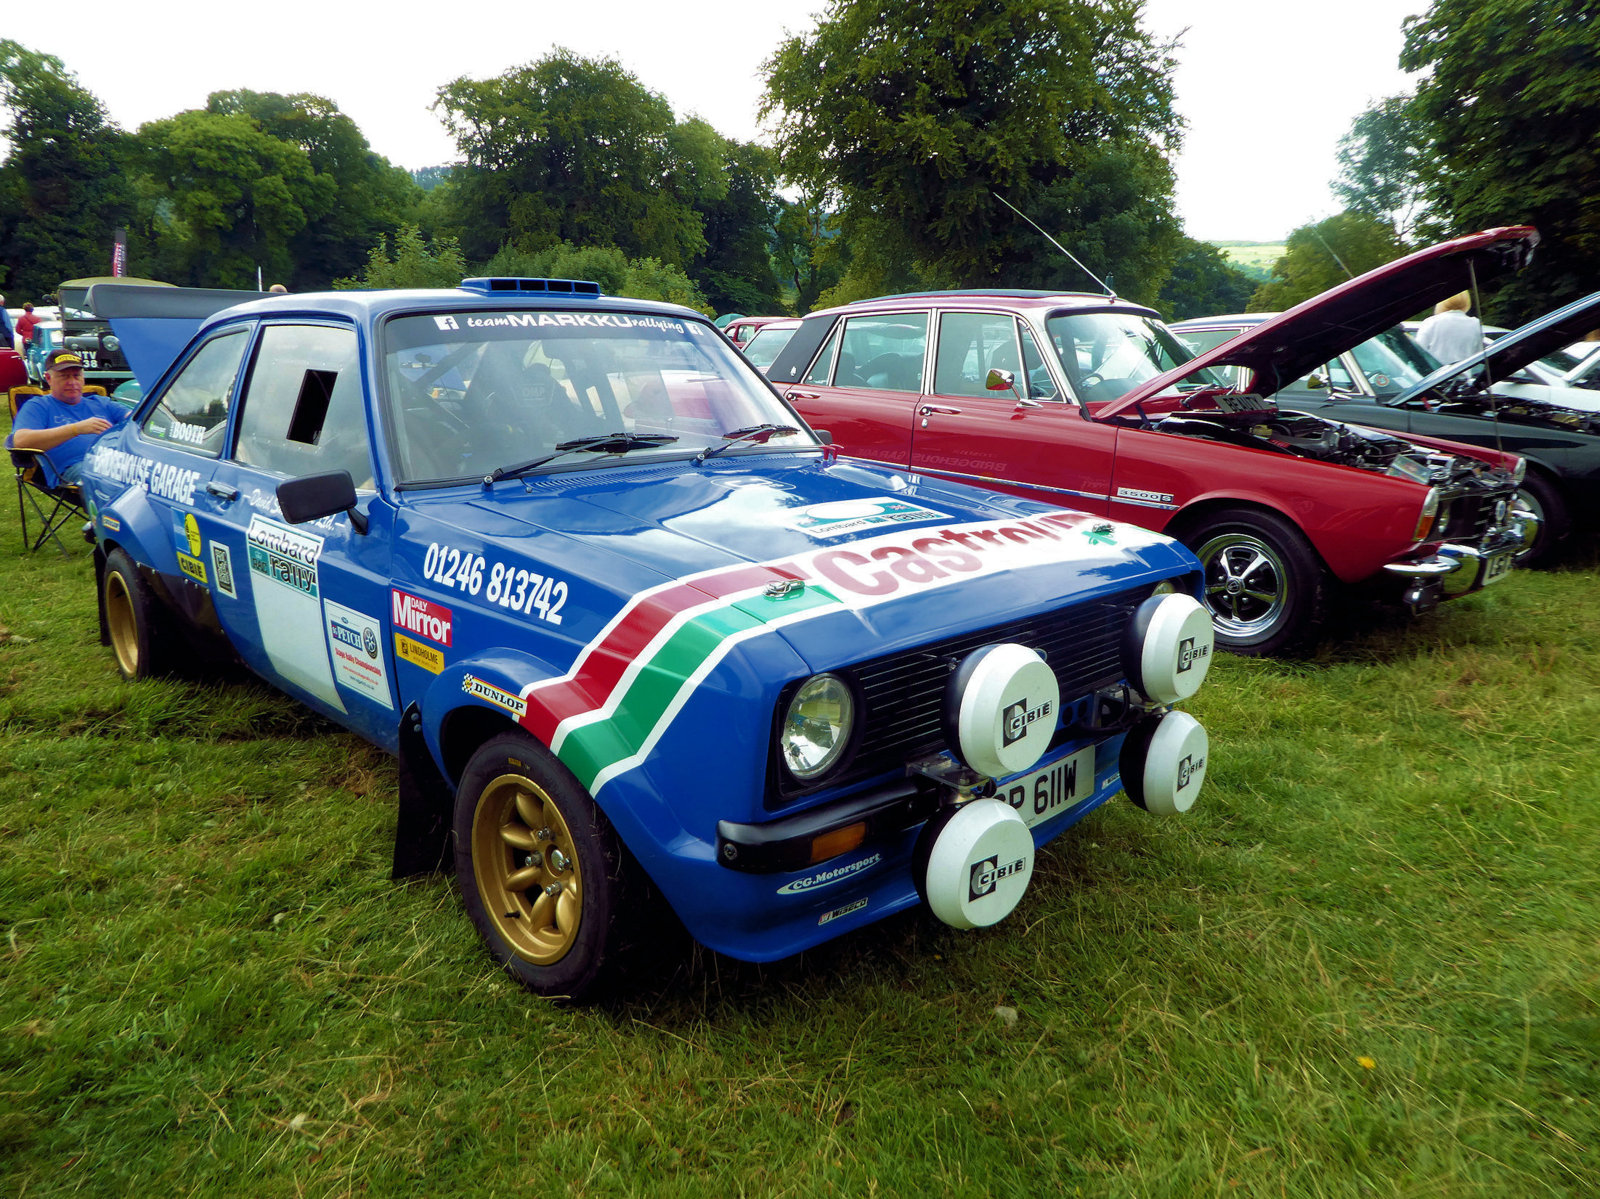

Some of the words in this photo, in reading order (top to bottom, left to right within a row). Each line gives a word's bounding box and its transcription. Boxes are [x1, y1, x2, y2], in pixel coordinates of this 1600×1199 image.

[83, 359, 98, 368] 38
[173, 421, 207, 445] BOOTH
[150, 462, 201, 506] GARAGE
[247, 520, 320, 566] Lombard
[810, 519, 866, 534] Lombard
[270, 553, 317, 592] rally
[812, 520, 1063, 597] Castrol
[423, 542, 486, 596] 01246
[486, 562, 569, 626] 813742
[392, 590, 451, 644] Mirror
[411, 597, 428, 612] DAILY
[337, 625, 362, 648] PETCH
[410, 642, 439, 665] LINDHOLME
[474, 682, 524, 711] DUNLOP
[1033, 760, 1078, 815] 611W
[792, 852, 881, 891] CG.Motorsport
